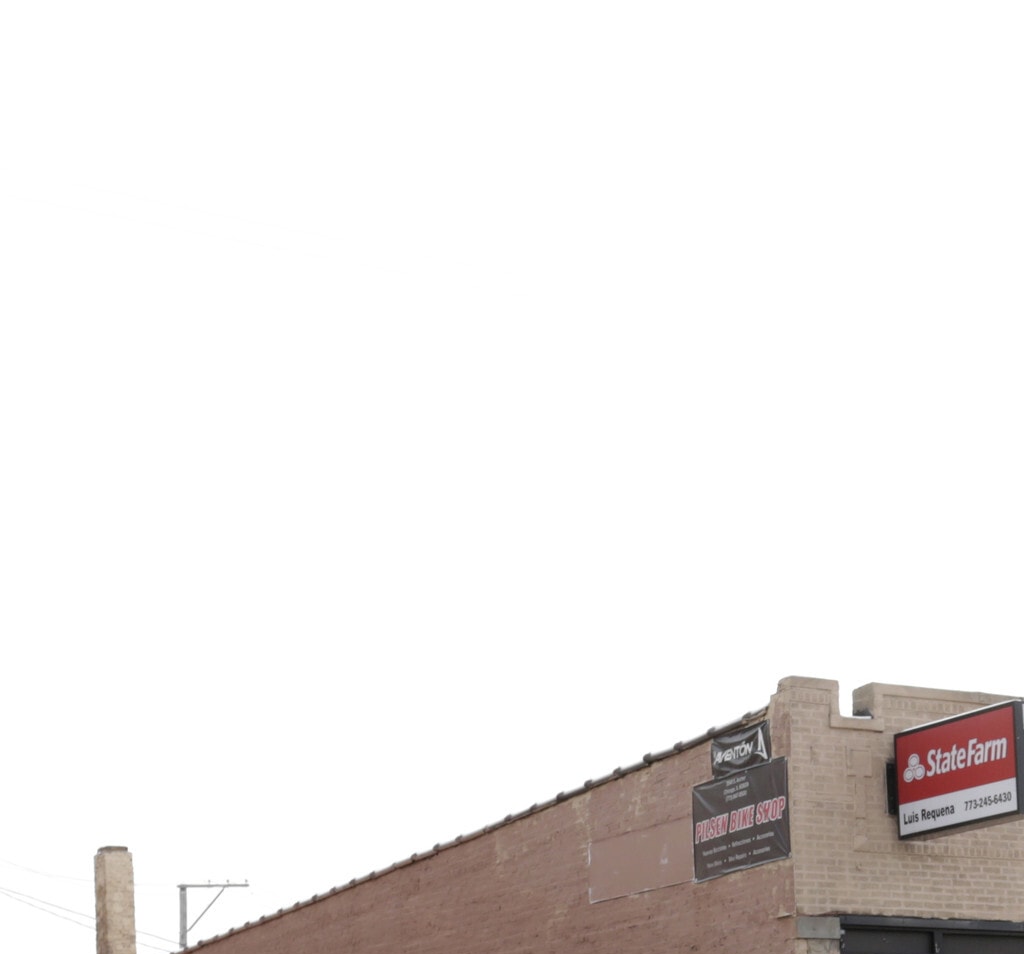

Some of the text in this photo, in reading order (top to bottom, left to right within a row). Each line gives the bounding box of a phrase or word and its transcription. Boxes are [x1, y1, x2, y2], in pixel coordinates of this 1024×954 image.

[695, 813, 729, 845] PILSEN
[729, 804, 755, 833] BIKE
[755, 796, 786, 825] SHOP
[903, 791, 1012, 826] Luis Requena 773-245-6430
